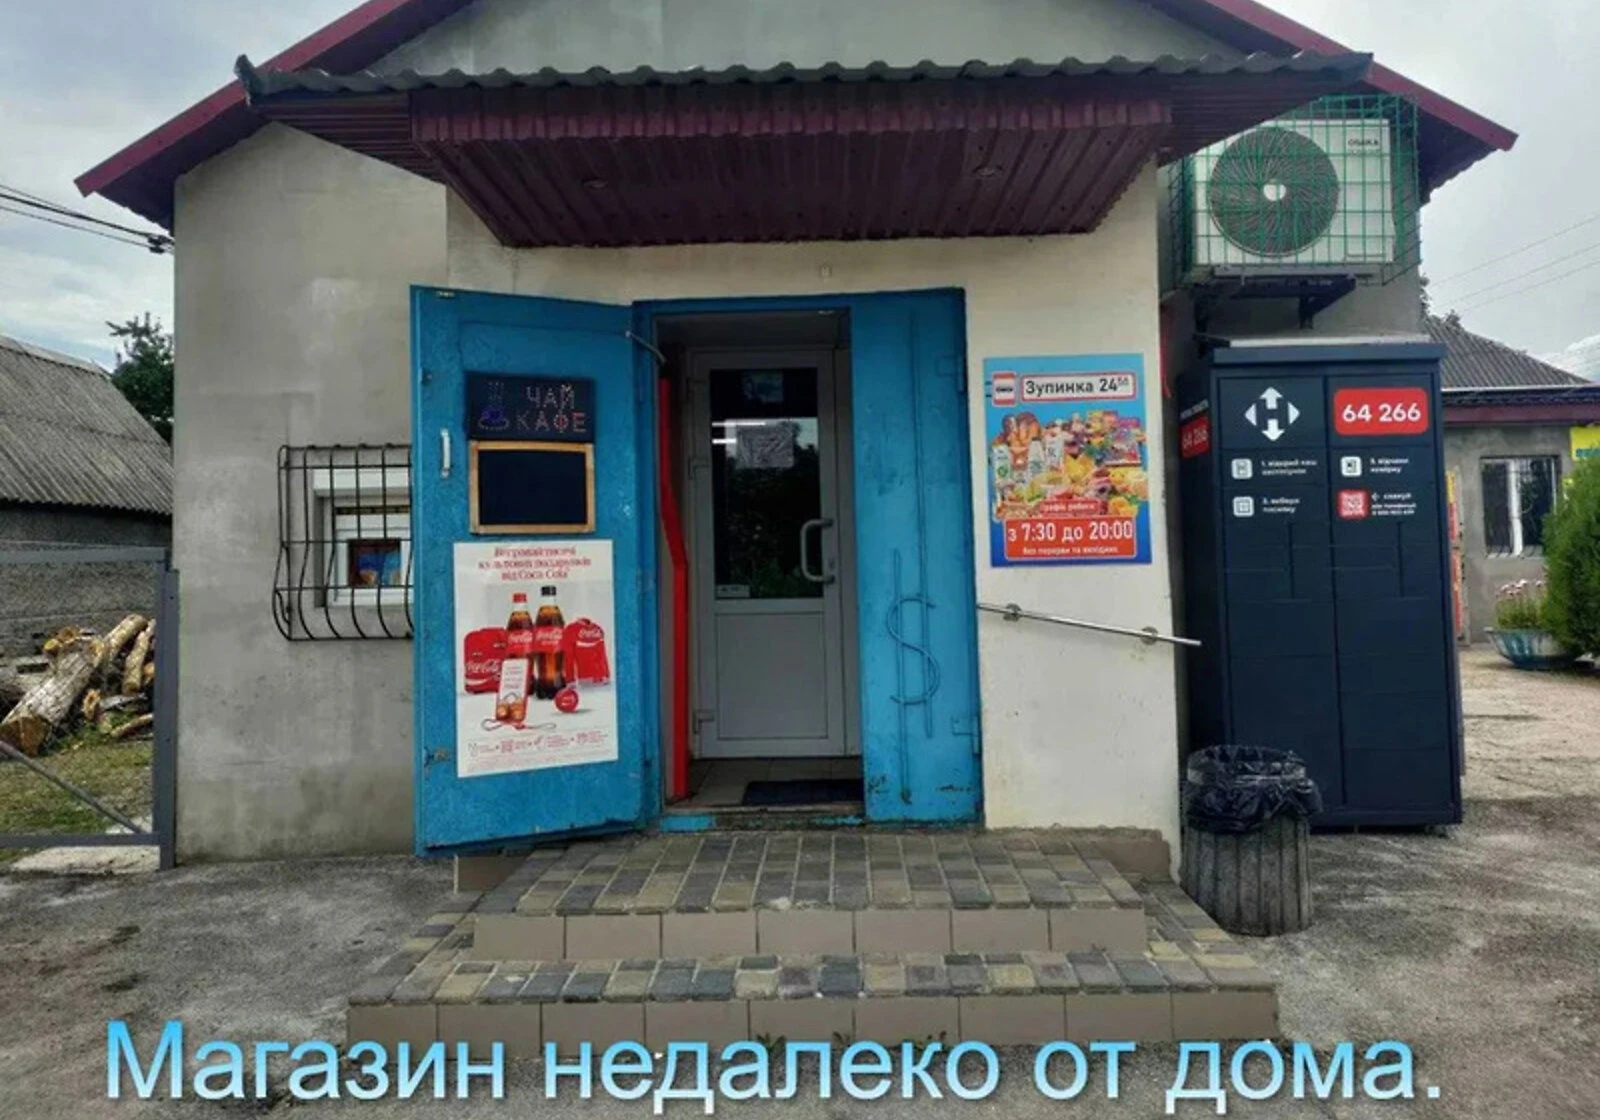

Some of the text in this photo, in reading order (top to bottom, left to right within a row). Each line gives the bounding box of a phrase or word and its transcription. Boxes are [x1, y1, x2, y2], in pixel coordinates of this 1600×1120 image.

[526, 384, 575, 409] ЧАЙ
[1025, 379, 1094, 397] Зупинка
[515, 409, 587, 433] КАФЕ
[1342, 402, 1421, 423] 64 266
[1021, 522, 1056, 541] 7:30
[1061, 526, 1083, 543] до
[1089, 520, 1133, 540] 20:00
